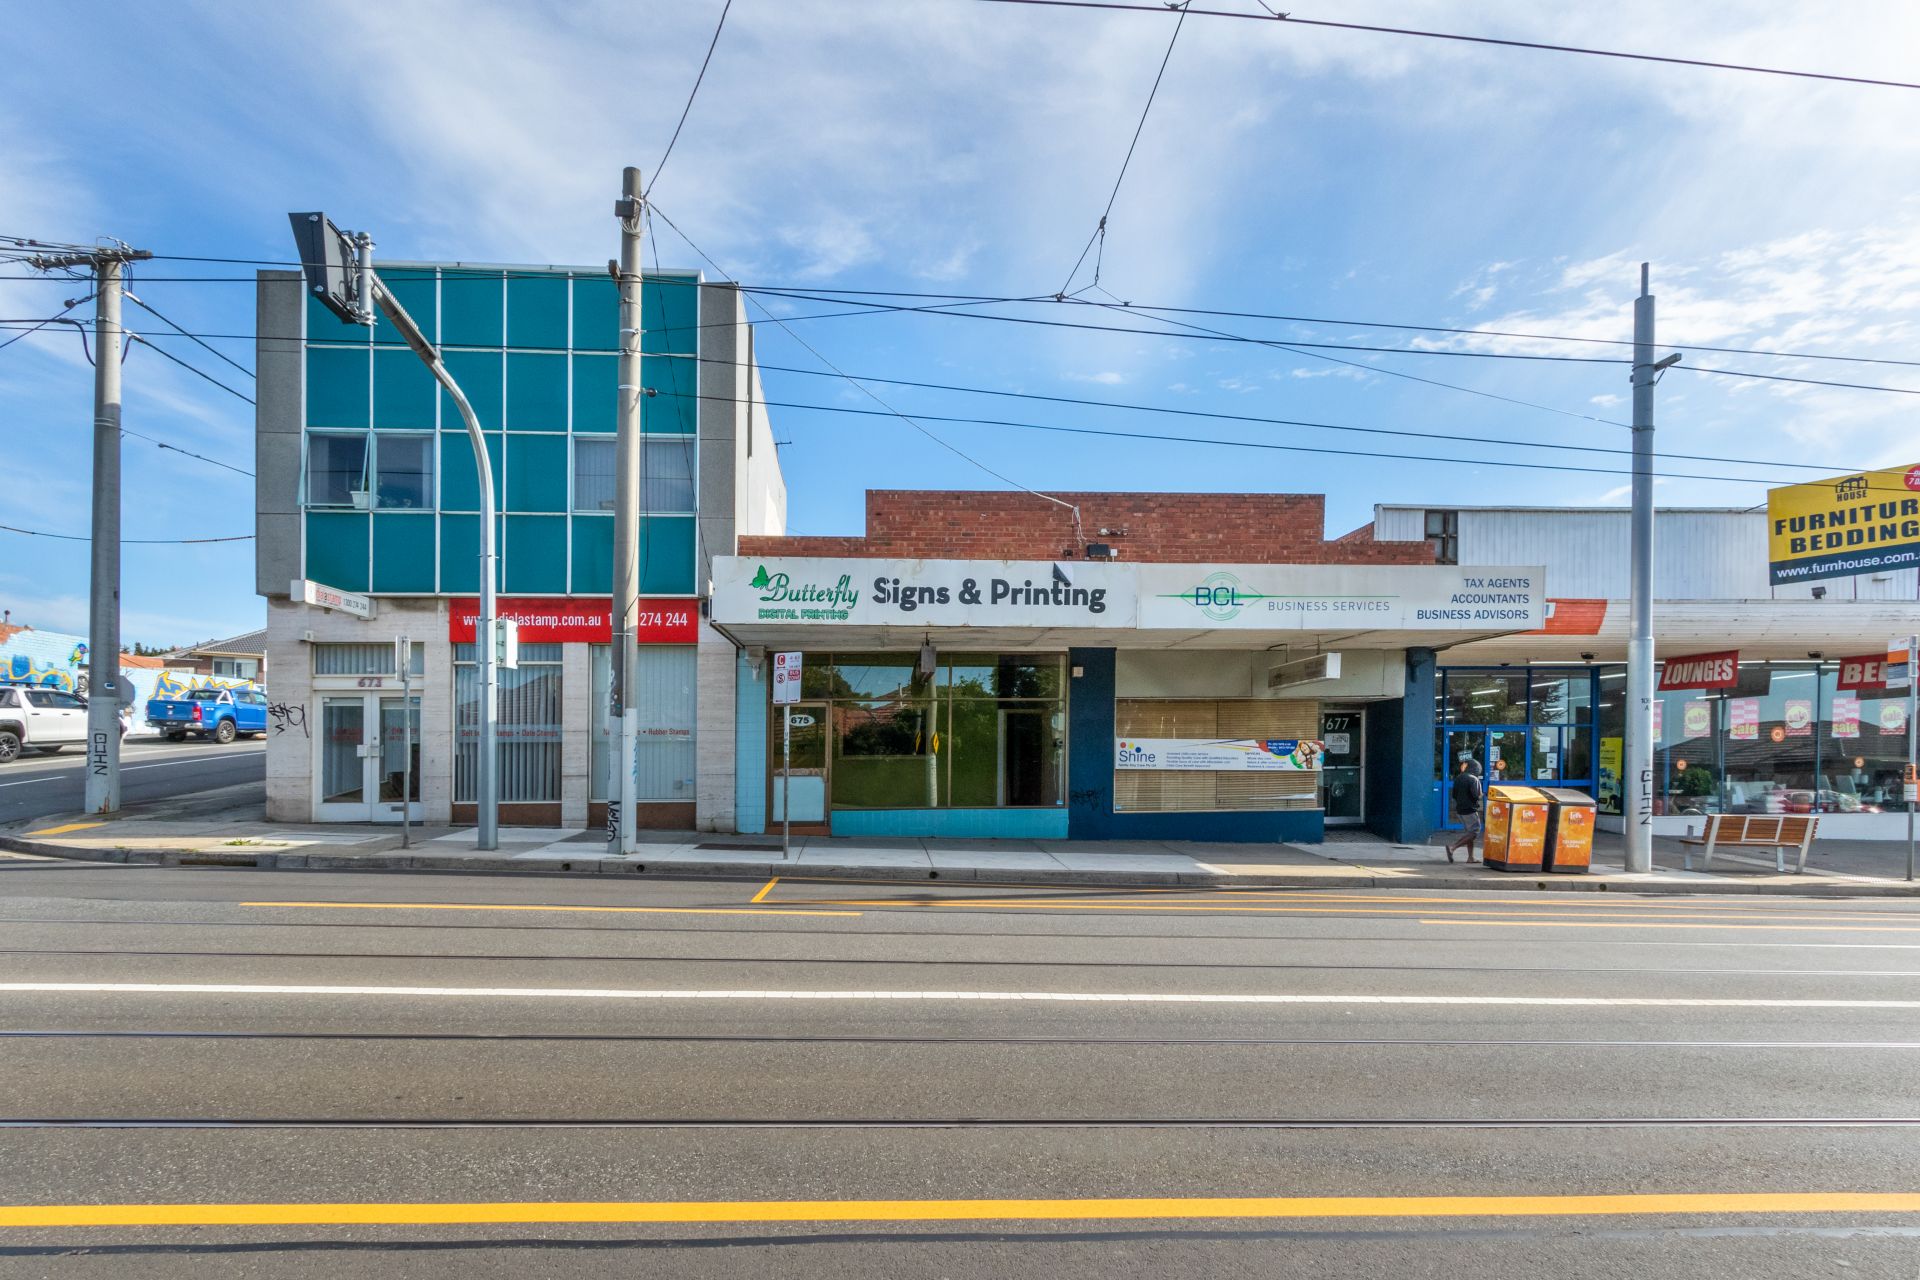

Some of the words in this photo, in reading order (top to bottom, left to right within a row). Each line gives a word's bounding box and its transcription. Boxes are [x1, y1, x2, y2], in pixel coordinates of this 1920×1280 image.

[1837, 490, 1867, 502] HOUSE
[1790, 520, 1920, 554] BEDDING
[1776, 551, 1920, 578] www.furnhouse.com.
[1463, 578, 1485, 588] TAX
[1487, 578, 1530, 588] AGENTS
[759, 573, 860, 609] Butterfly
[872, 577, 950, 611] Signs
[958, 578, 983, 605] &
[991, 578, 1106, 613] Printing
[1195, 586, 1244, 606] BCL
[1451, 593, 1530, 604] ACCOUNTANTS
[1268, 601, 1328, 611] BUSINESS
[1333, 601, 1391, 611] SERVICES
[639, 612, 661, 626] 274
[665, 612, 688, 626] 244
[758, 609, 798, 620] DIGITAL
[800, 609, 849, 620] PRINTING
[1417, 609, 1471, 620] BUSINESS
[1473, 609, 1529, 620] ADVISORS
[1663, 658, 1734, 685] LOUNGES
[358, 677, 383, 688] 673
[791, 716, 809, 724] 675
[1326, 717, 1350, 730] 677
[1731, 722, 1758, 735] sale
[1832, 721, 1858, 733] sale
[1119, 747, 1156, 763] Shine
